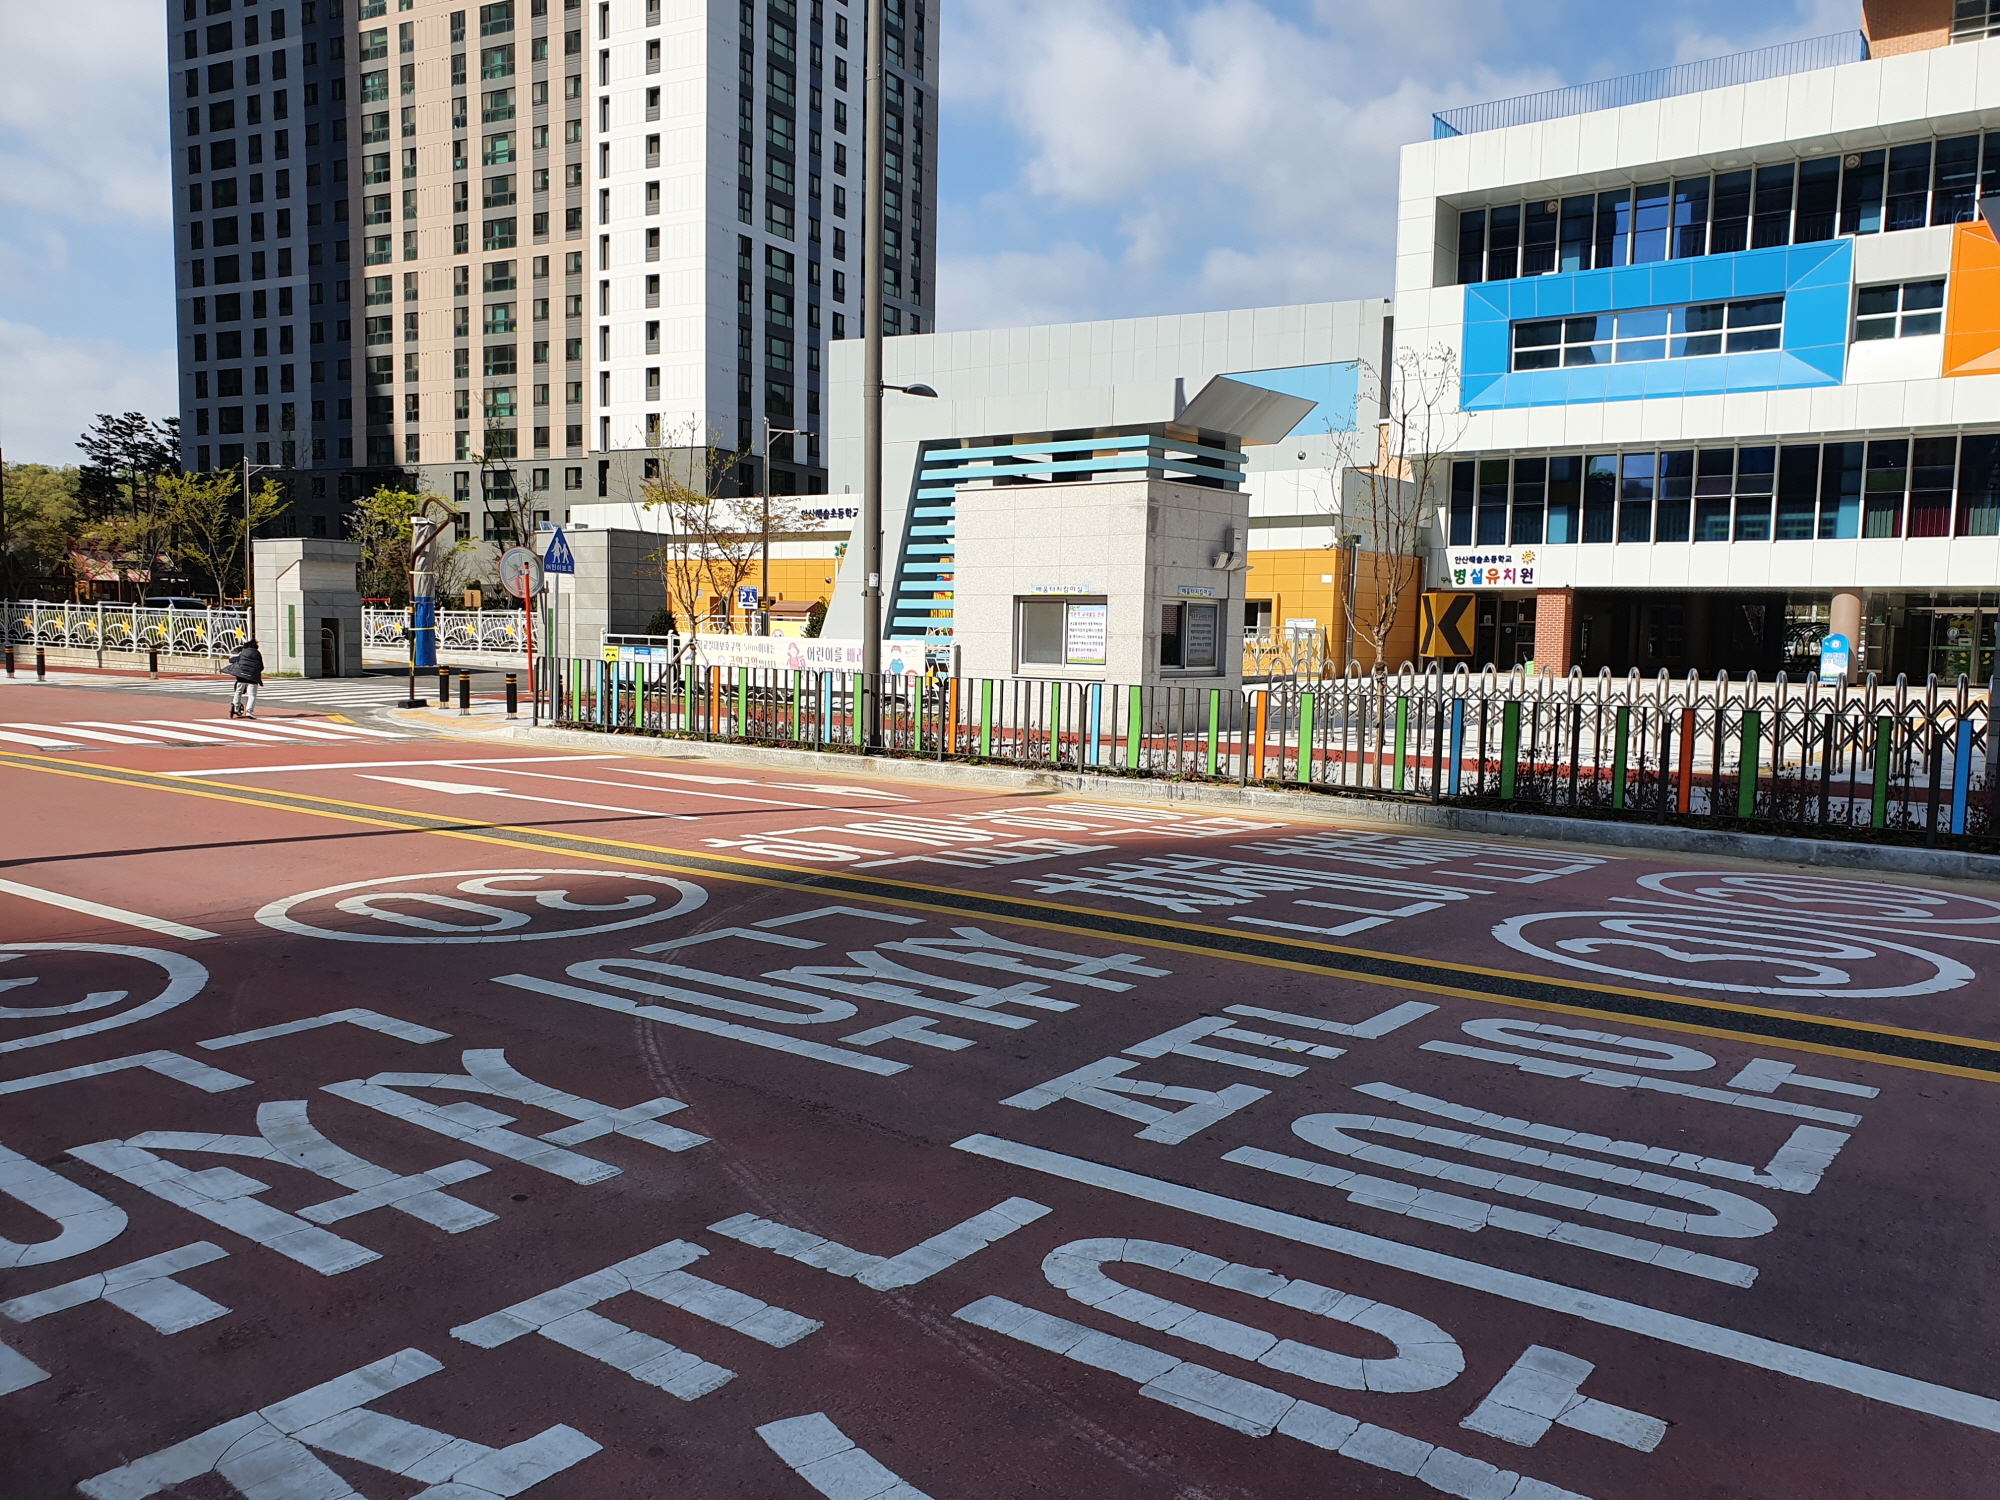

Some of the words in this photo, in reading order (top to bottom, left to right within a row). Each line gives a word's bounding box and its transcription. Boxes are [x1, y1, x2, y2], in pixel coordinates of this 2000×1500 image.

[1453, 568, 1534, 585] 병설유치원
[1454, 554, 1512, 564] 안산예술초등학교
[740, 591, 747, 602] P
[807, 646, 842, 662] 어린이를
[335, 875, 657, 932] 30
[1011, 853, 1497, 936] 천천히
[1694, 874, 1948, 919] 30
[1555, 916, 1878, 986] 30
[489, 905, 1173, 1077] 천천히
[1000, 1001, 1880, 1288] 학교앞
